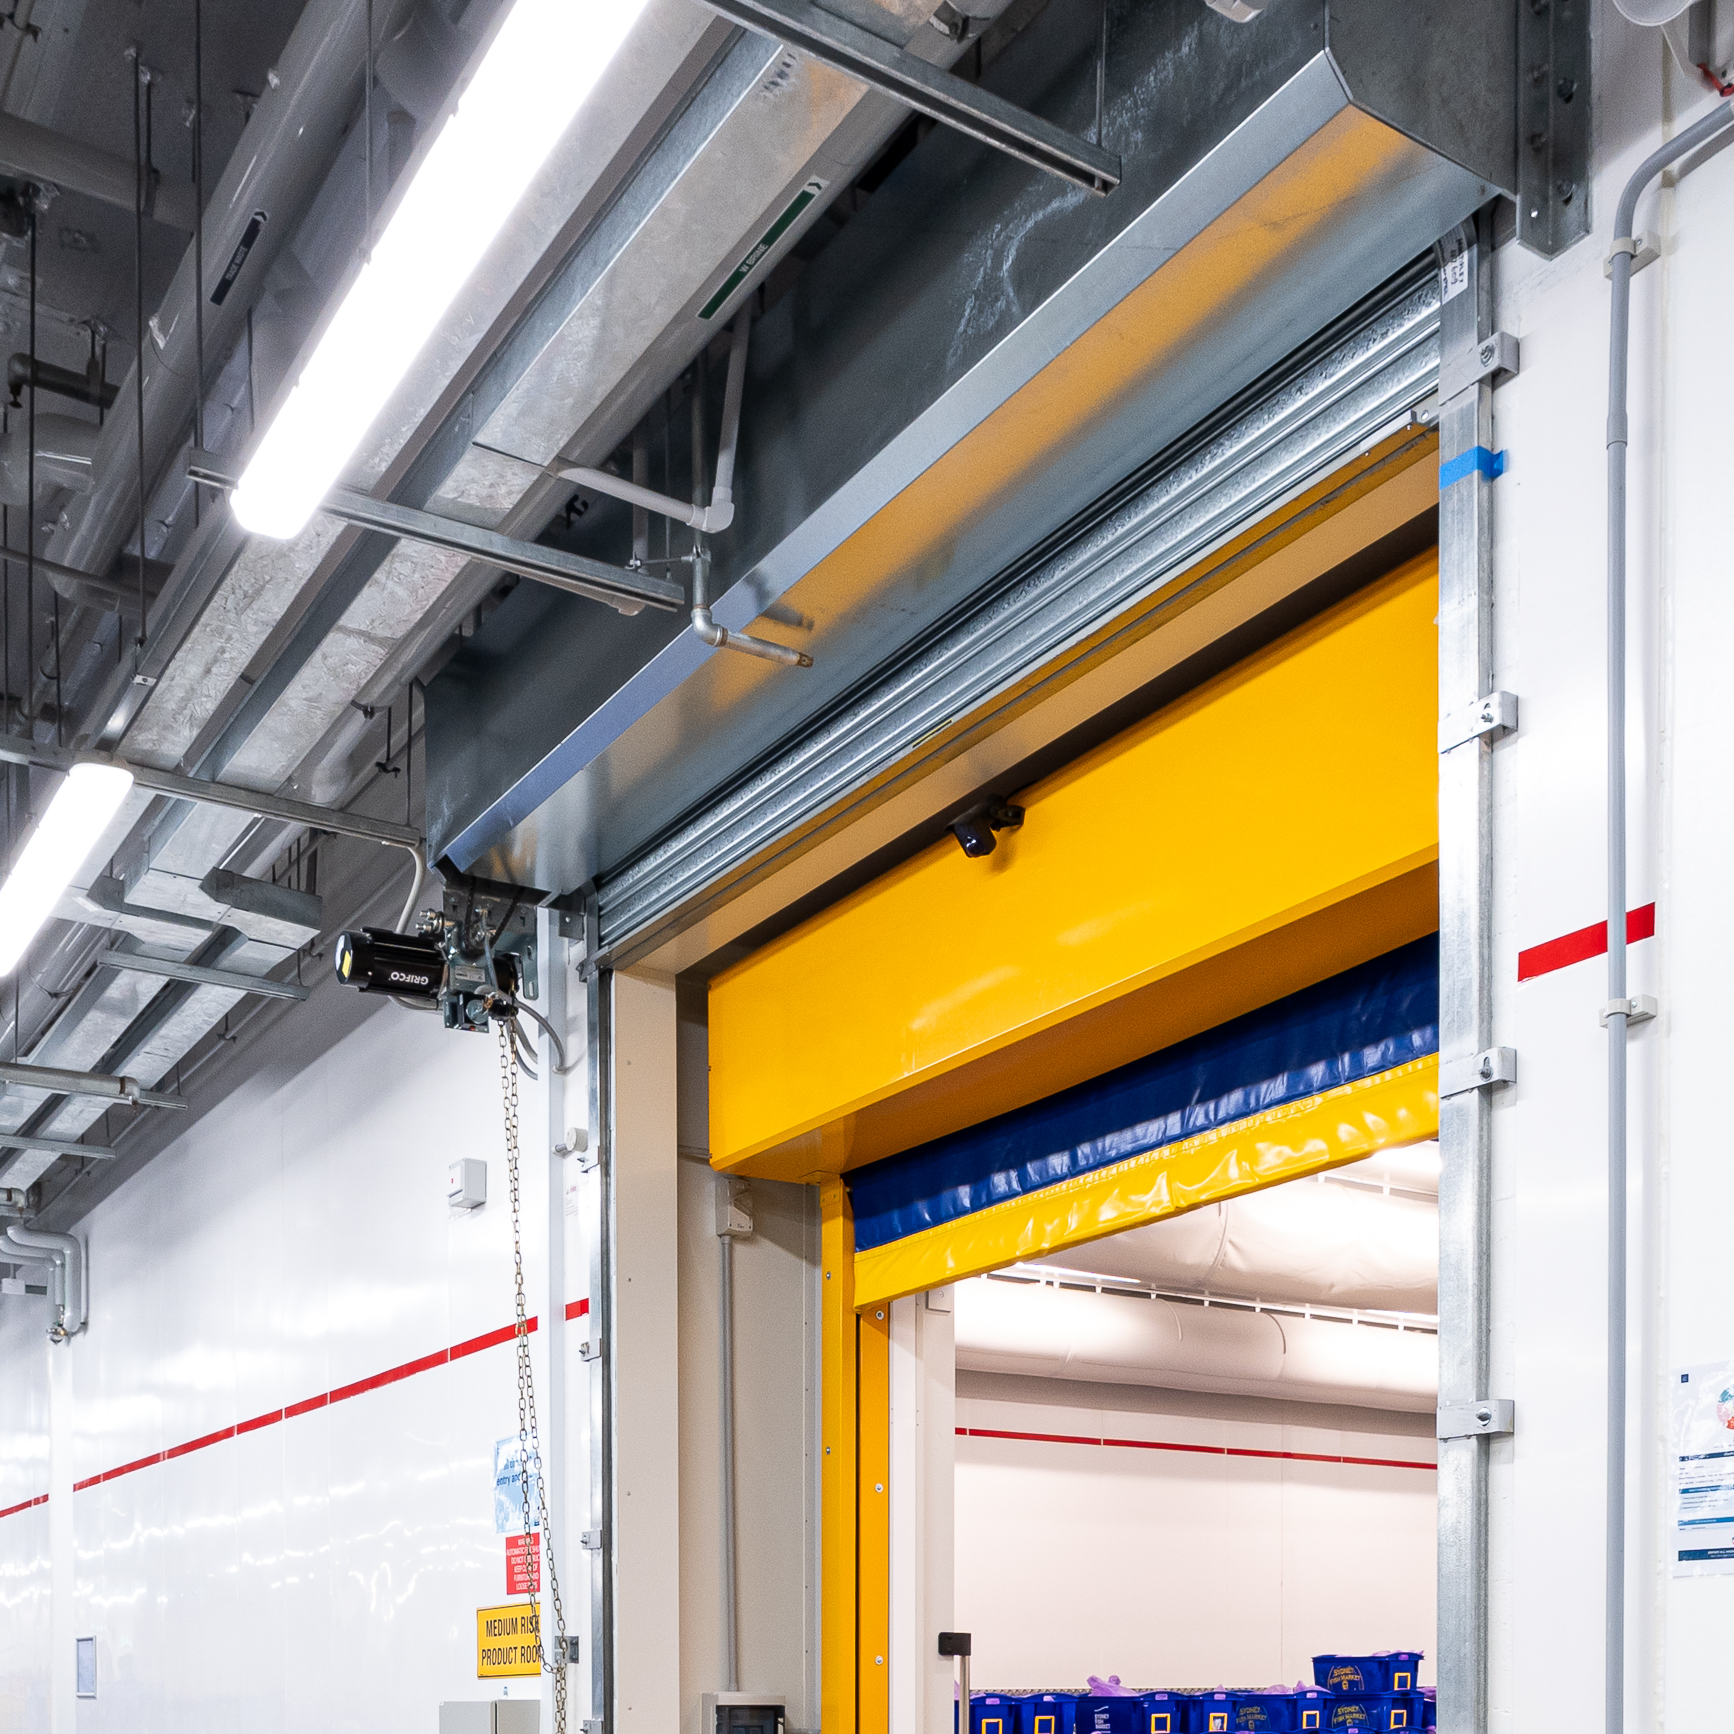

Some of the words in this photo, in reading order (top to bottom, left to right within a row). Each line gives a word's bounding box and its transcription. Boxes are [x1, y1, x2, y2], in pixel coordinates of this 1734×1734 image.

[390, 971, 429, 985] GRIFCO
[486, 1617, 518, 1637] MEDIUM
[482, 1646, 518, 1666] PRODUCT
